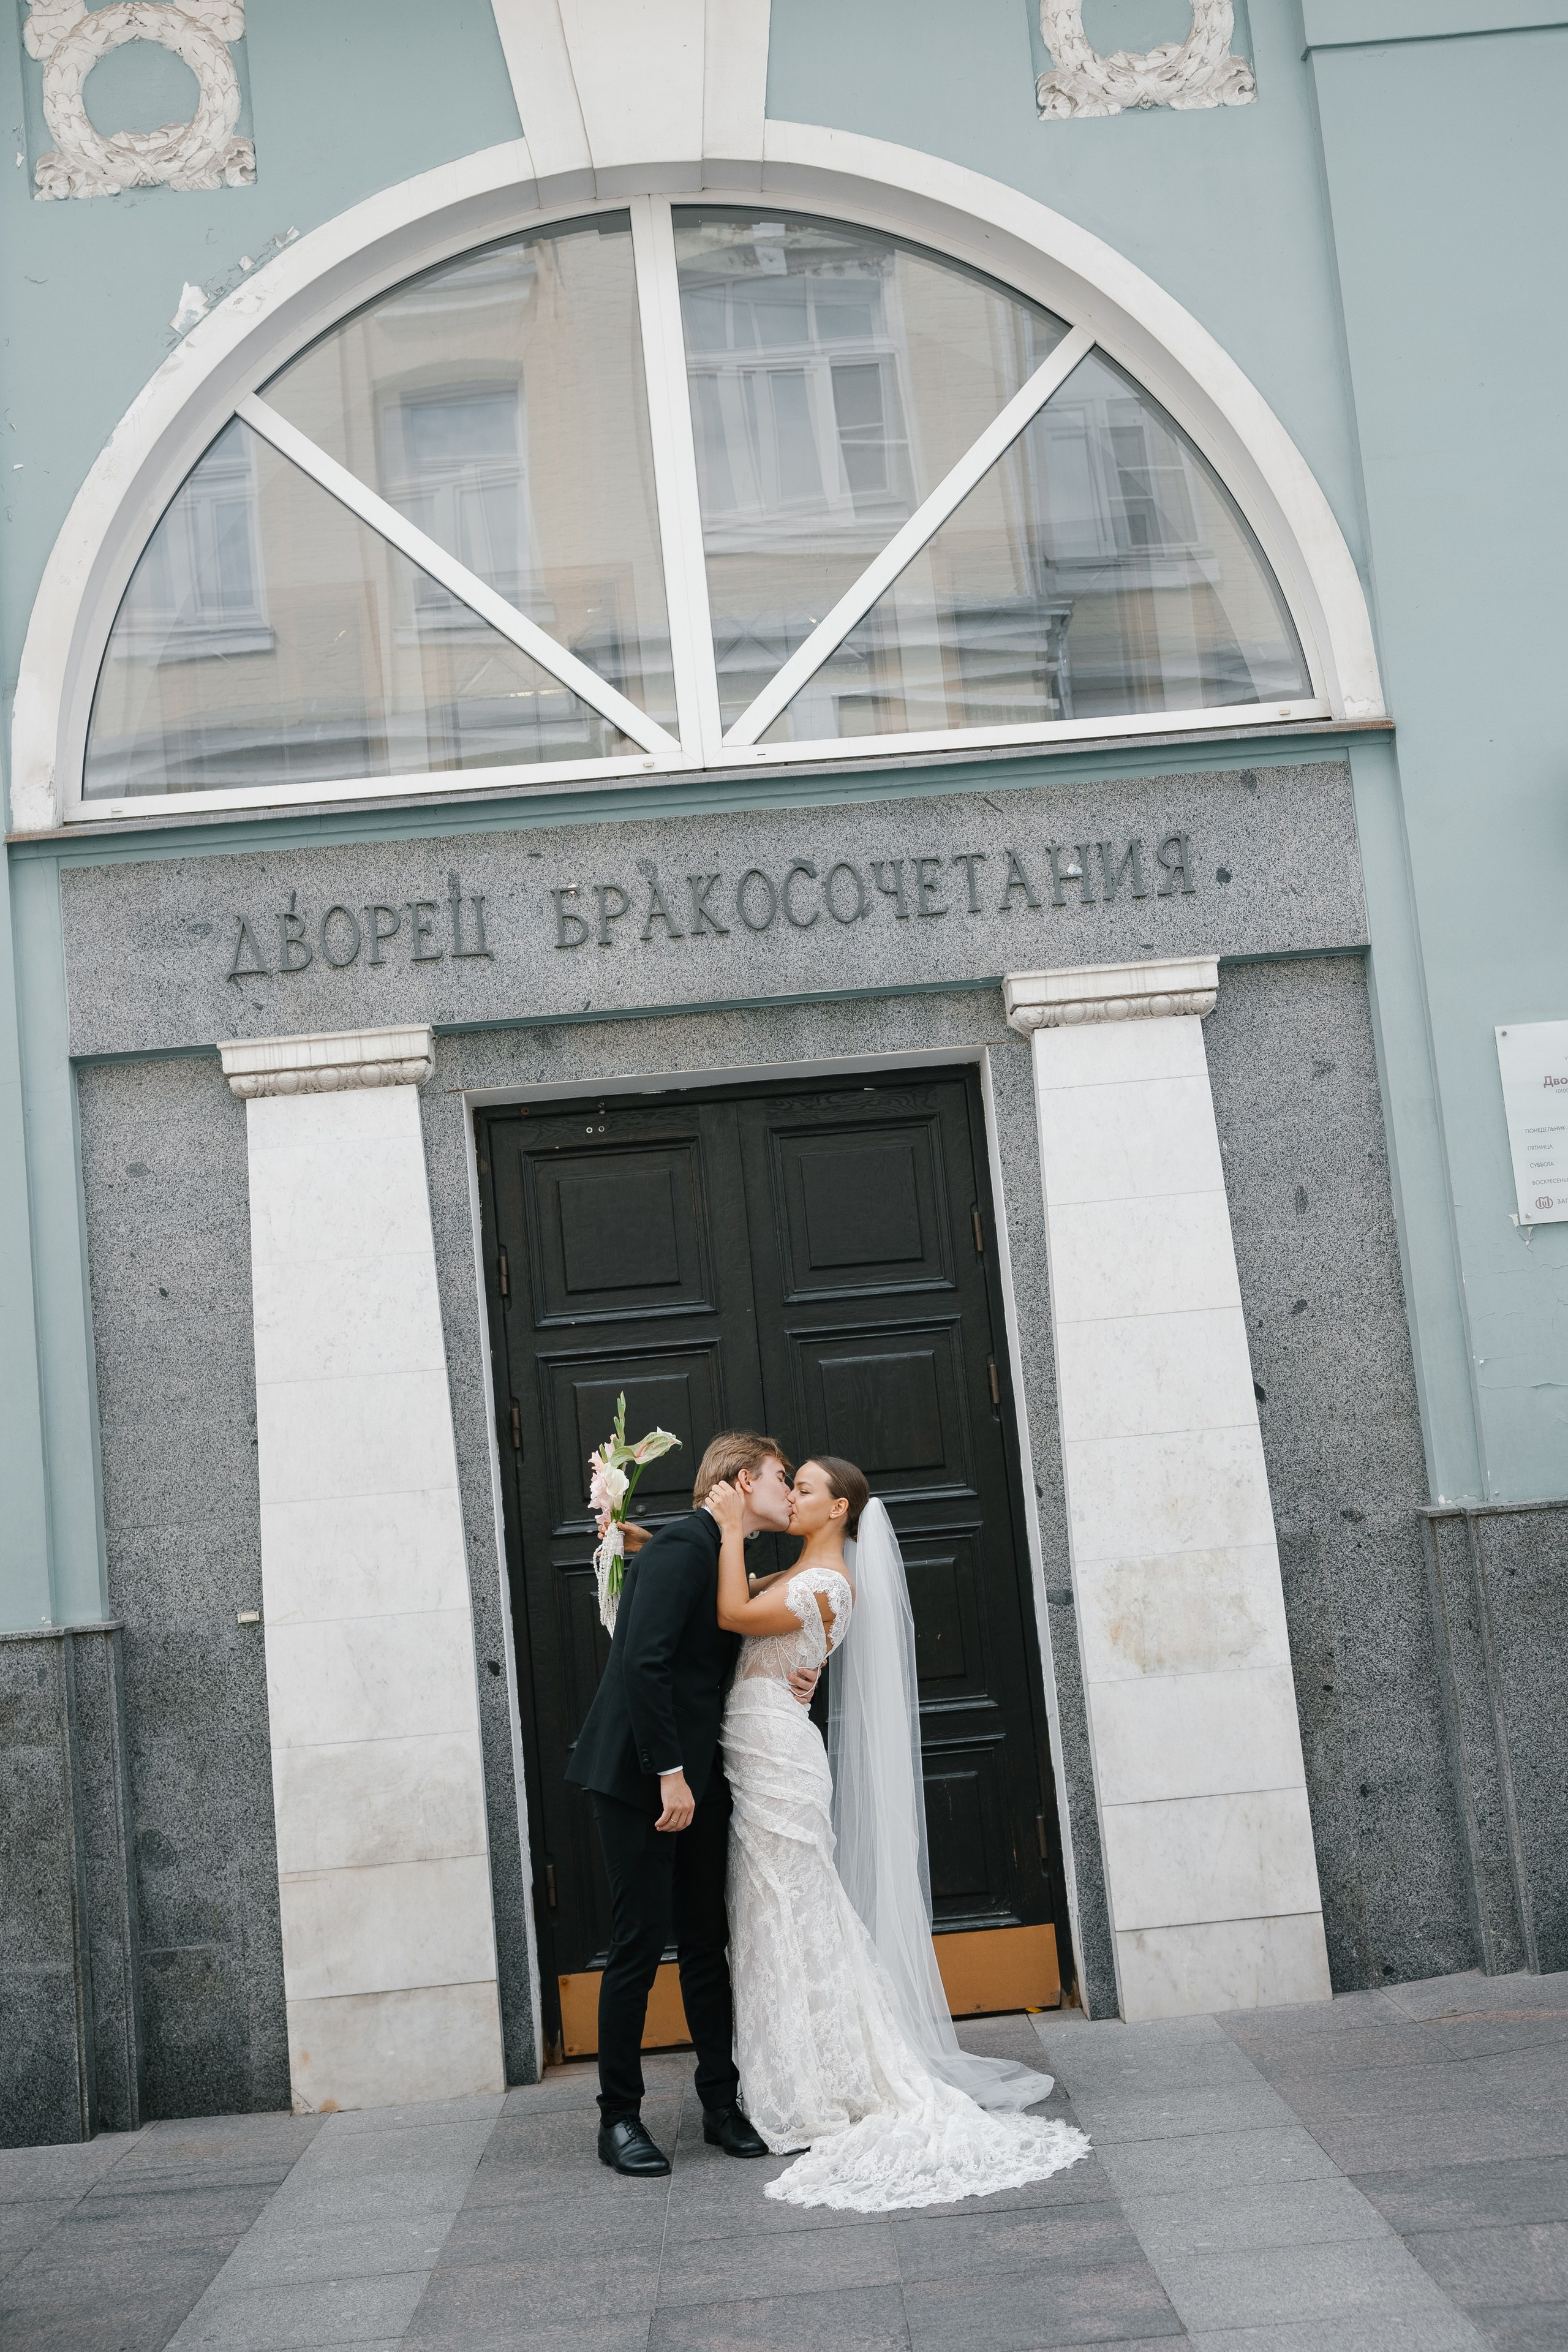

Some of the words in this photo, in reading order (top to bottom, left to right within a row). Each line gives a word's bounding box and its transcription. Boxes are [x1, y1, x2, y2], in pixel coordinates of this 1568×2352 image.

[226, 894, 494, 978] ДВОРЕЦ
[550, 834, 1196, 949] БРАКОСОЧЕТАНИЯ
[1544, 1076, 1568, 1088] Дво
